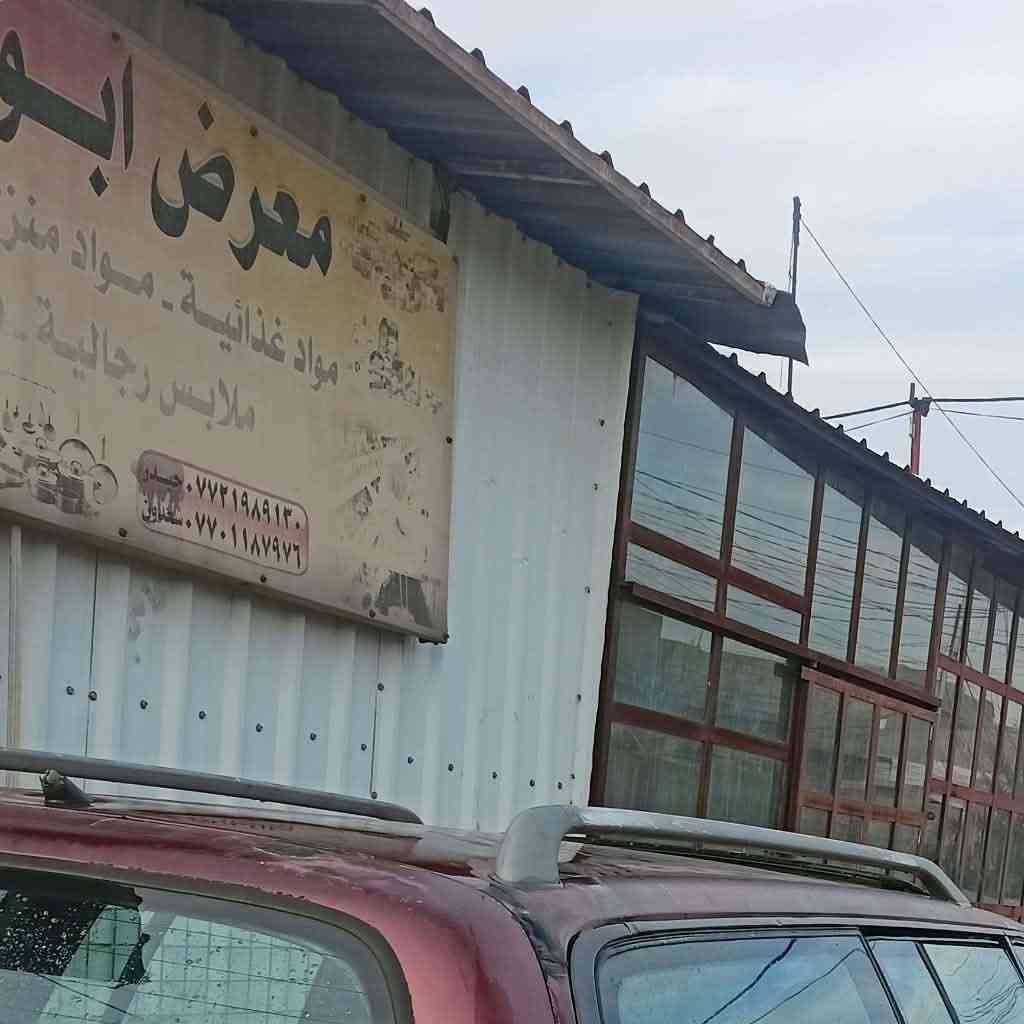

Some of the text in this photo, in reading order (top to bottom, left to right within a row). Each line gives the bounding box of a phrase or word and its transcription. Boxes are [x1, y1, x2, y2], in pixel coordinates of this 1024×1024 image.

[150, 100, 333, 277] معرض
[71, 226, 154, 300] مواد
[36, 296, 150, 403] رجالية
[180, 268, 286, 363] غذائية
[160, 376, 255, 432] ملابس
[293, 334, 338, 391] مواد
